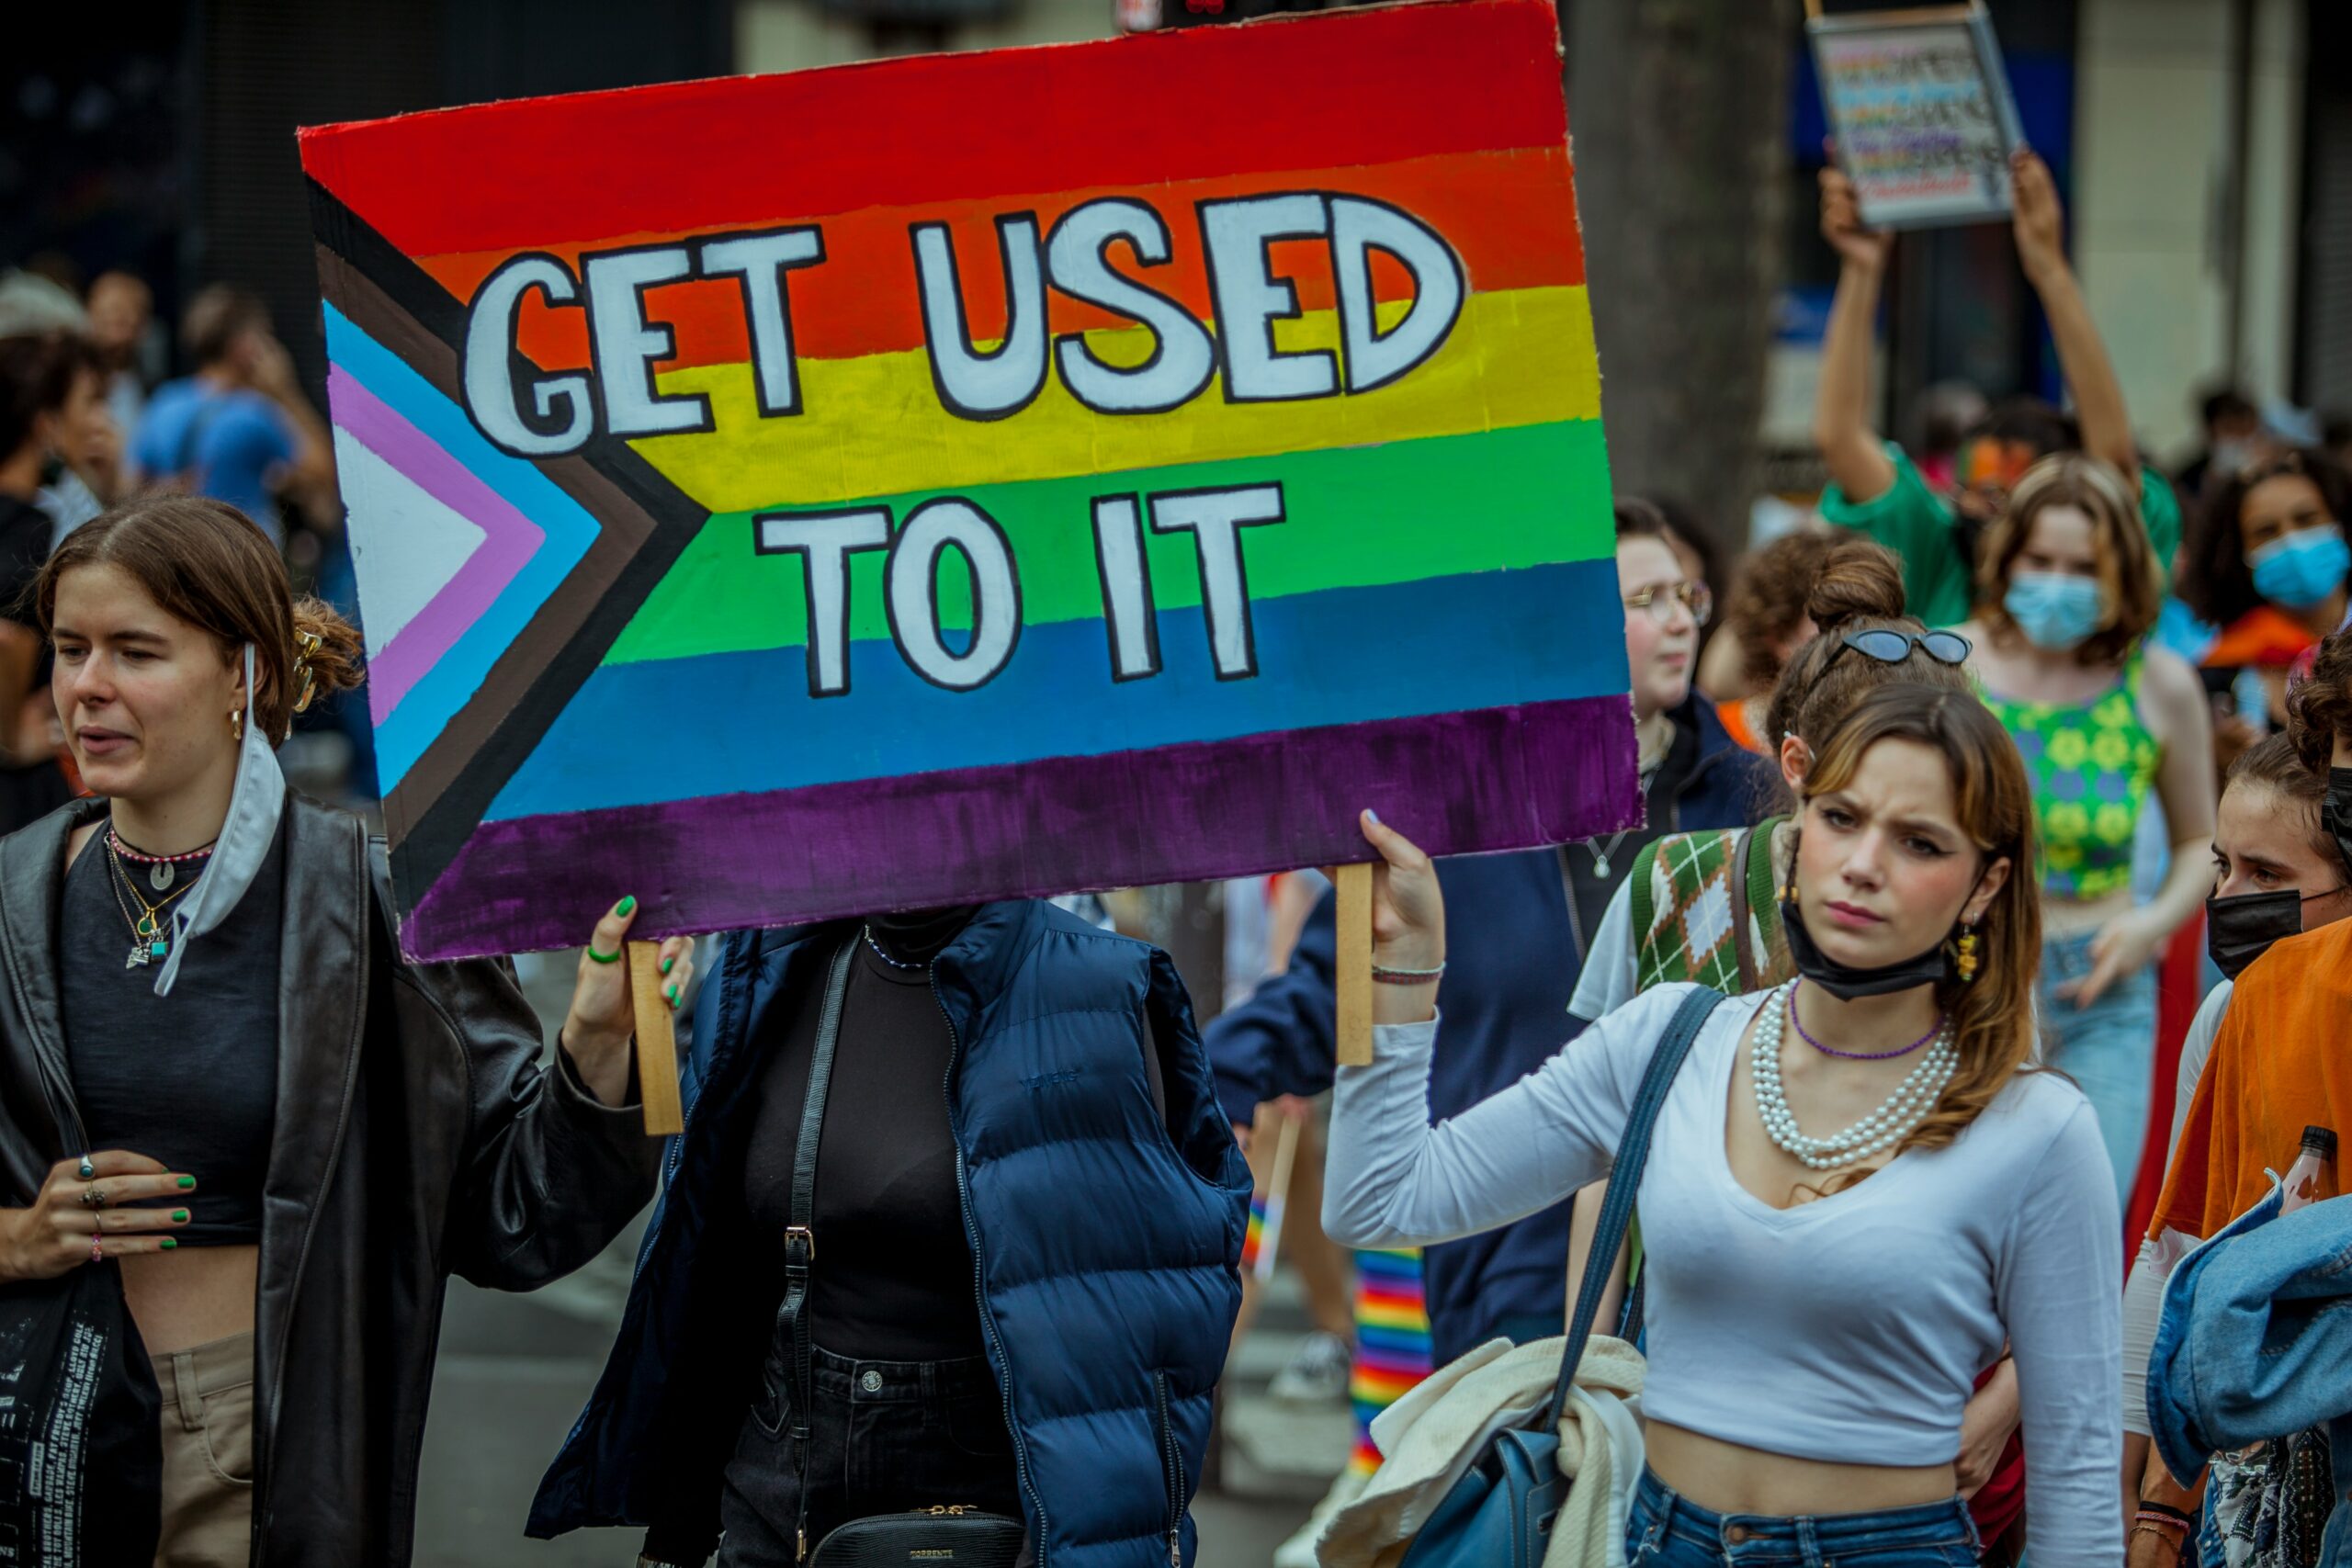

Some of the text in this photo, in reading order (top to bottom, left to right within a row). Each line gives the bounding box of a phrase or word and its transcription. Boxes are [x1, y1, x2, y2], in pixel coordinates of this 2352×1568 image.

[463, 190, 1468, 457] GET USED
[752, 481, 1287, 697] TO IT
[48, 1442, 58, 1460] FAT
[68, 1346, 79, 1372] LLOYD
[60, 1421, 72, 1448] STEVE
[54, 1488, 63, 1505] LES
[65, 1471, 76, 1495] STEVE
[53, 1538, 62, 1552] TOY
